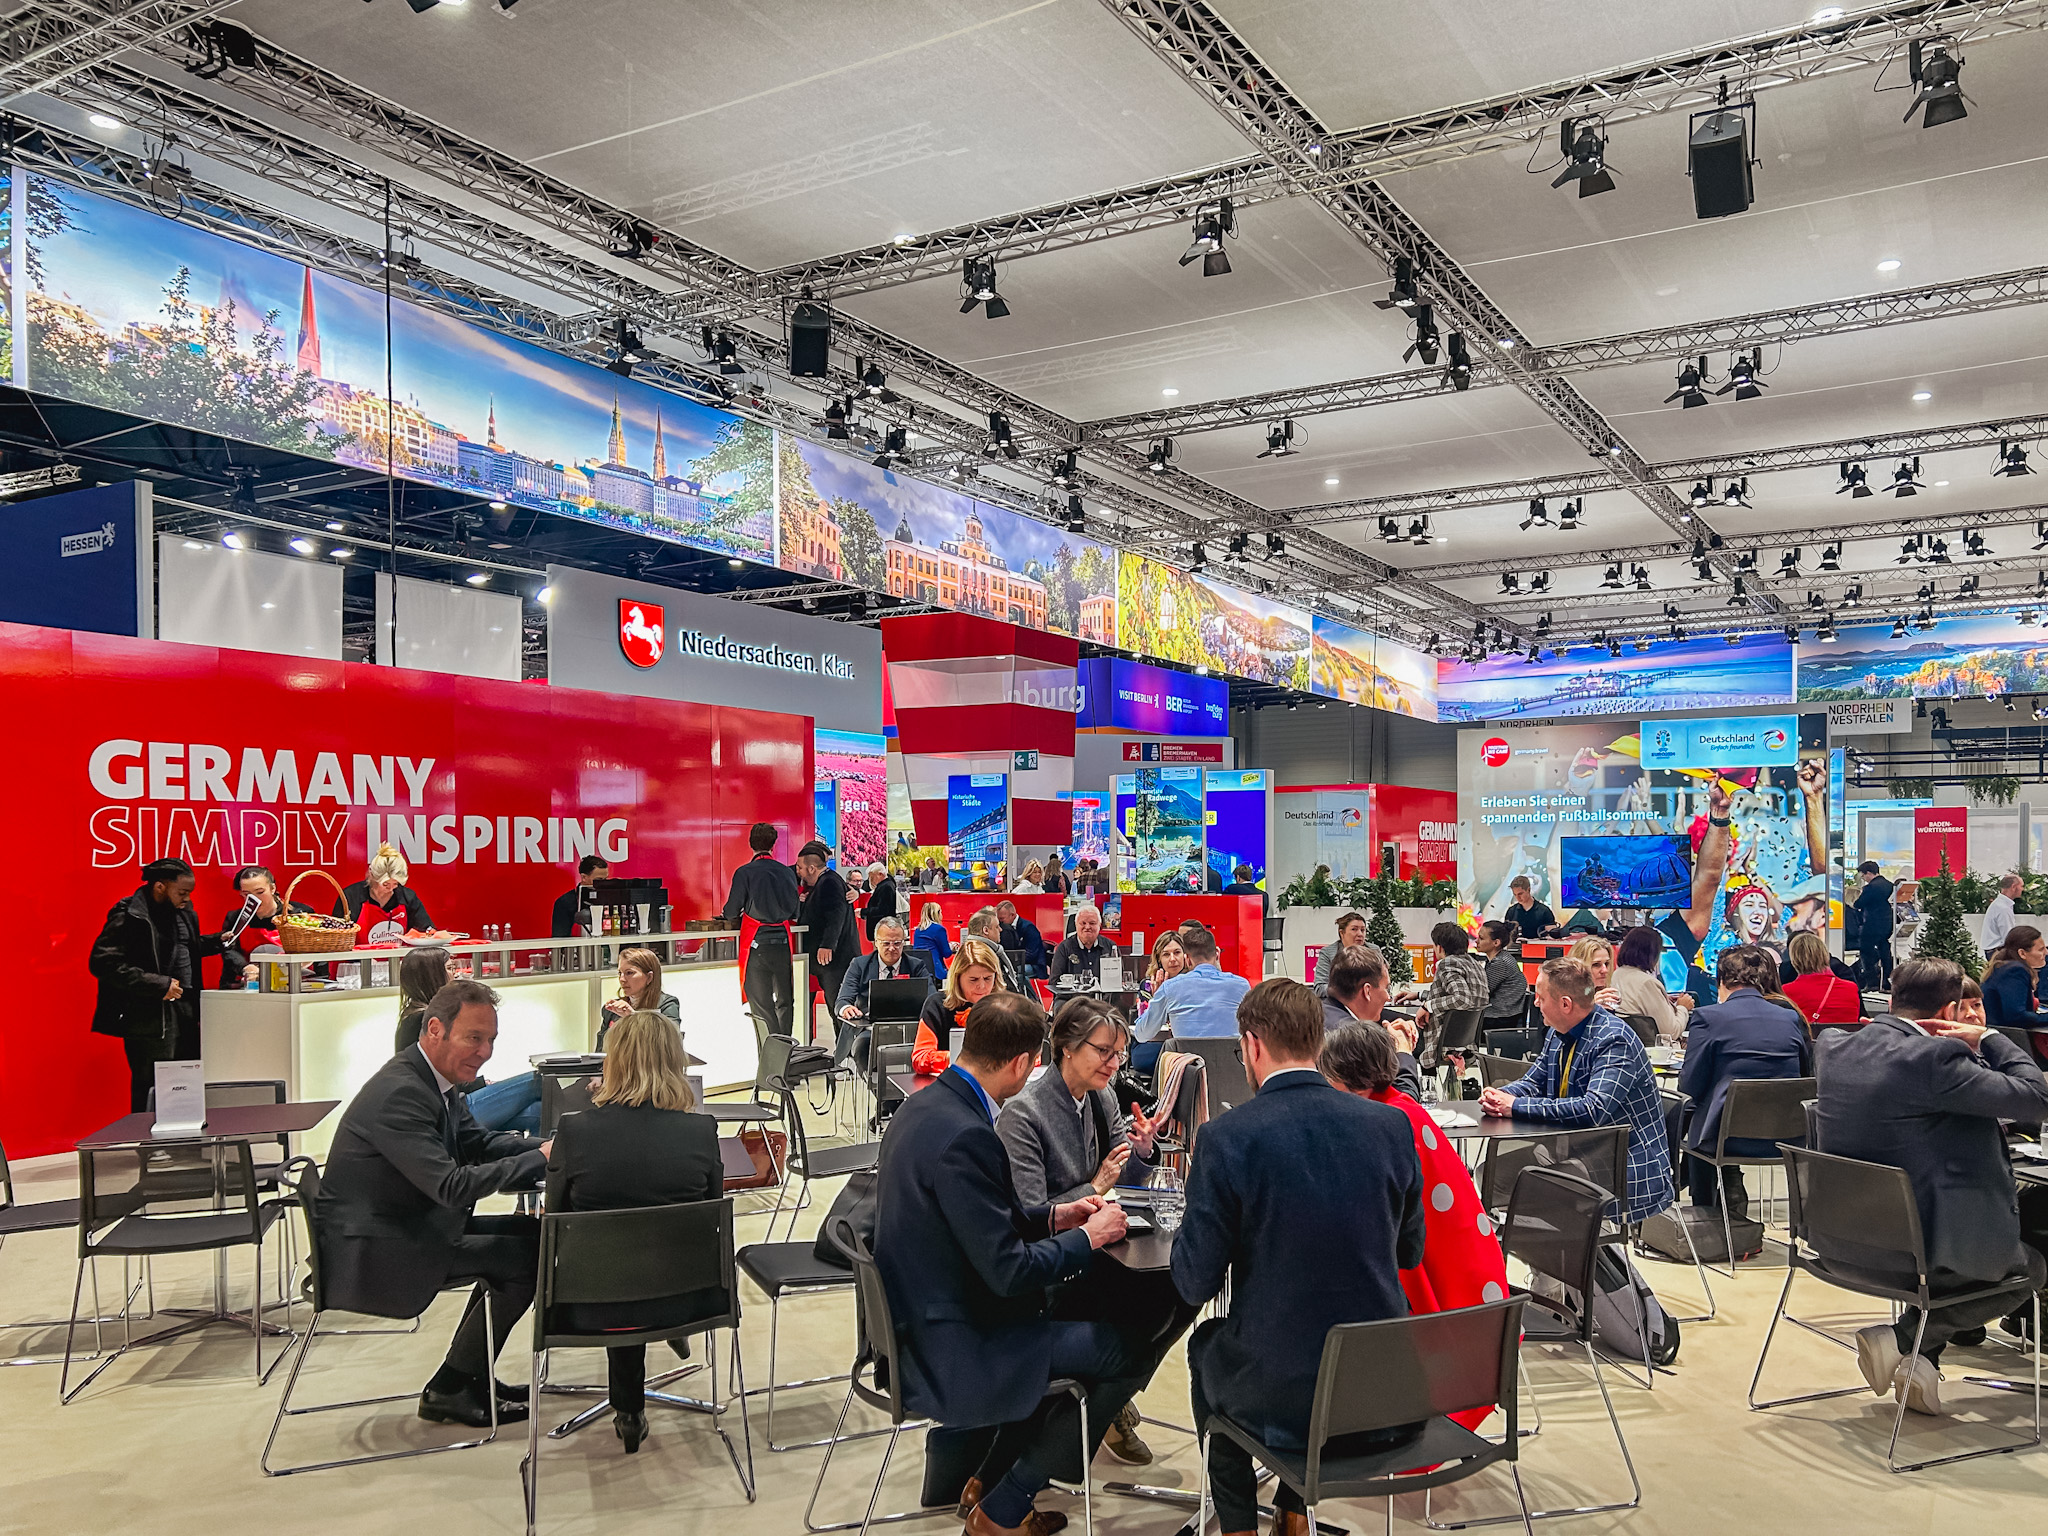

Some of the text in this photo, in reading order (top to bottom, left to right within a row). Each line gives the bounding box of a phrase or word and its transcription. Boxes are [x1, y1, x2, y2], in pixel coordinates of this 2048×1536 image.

[63, 535, 101, 553] HESSEN
[680, 630, 856, 679] Niedersachsen. Klar.
[1003, 680, 1086, 713] nburg
[1119, 689, 1153, 705] VISIT BERLIN
[1166, 695, 1183, 713] BER
[1829, 702, 1894, 715] NORDRHEIN
[1500, 719, 1554, 728] NORDRHEIN
[1699, 734, 1755, 744] Deutschland
[88, 739, 435, 807] GERMANY
[1147, 794, 1178, 803] Radwege
[1481, 794, 1586, 808] Erleben Sie einen
[1284, 811, 1334, 820] Deutschland
[1480, 809, 1663, 826] spannenden Fußballsommer.
[90, 805, 629, 869] SIMPLY INSPIRING
[1418, 820, 1457, 841] GERMANY
[1917, 825, 1965, 833] WÜRTTEMBERG
[1418, 842, 1448, 863] SIMPLY
